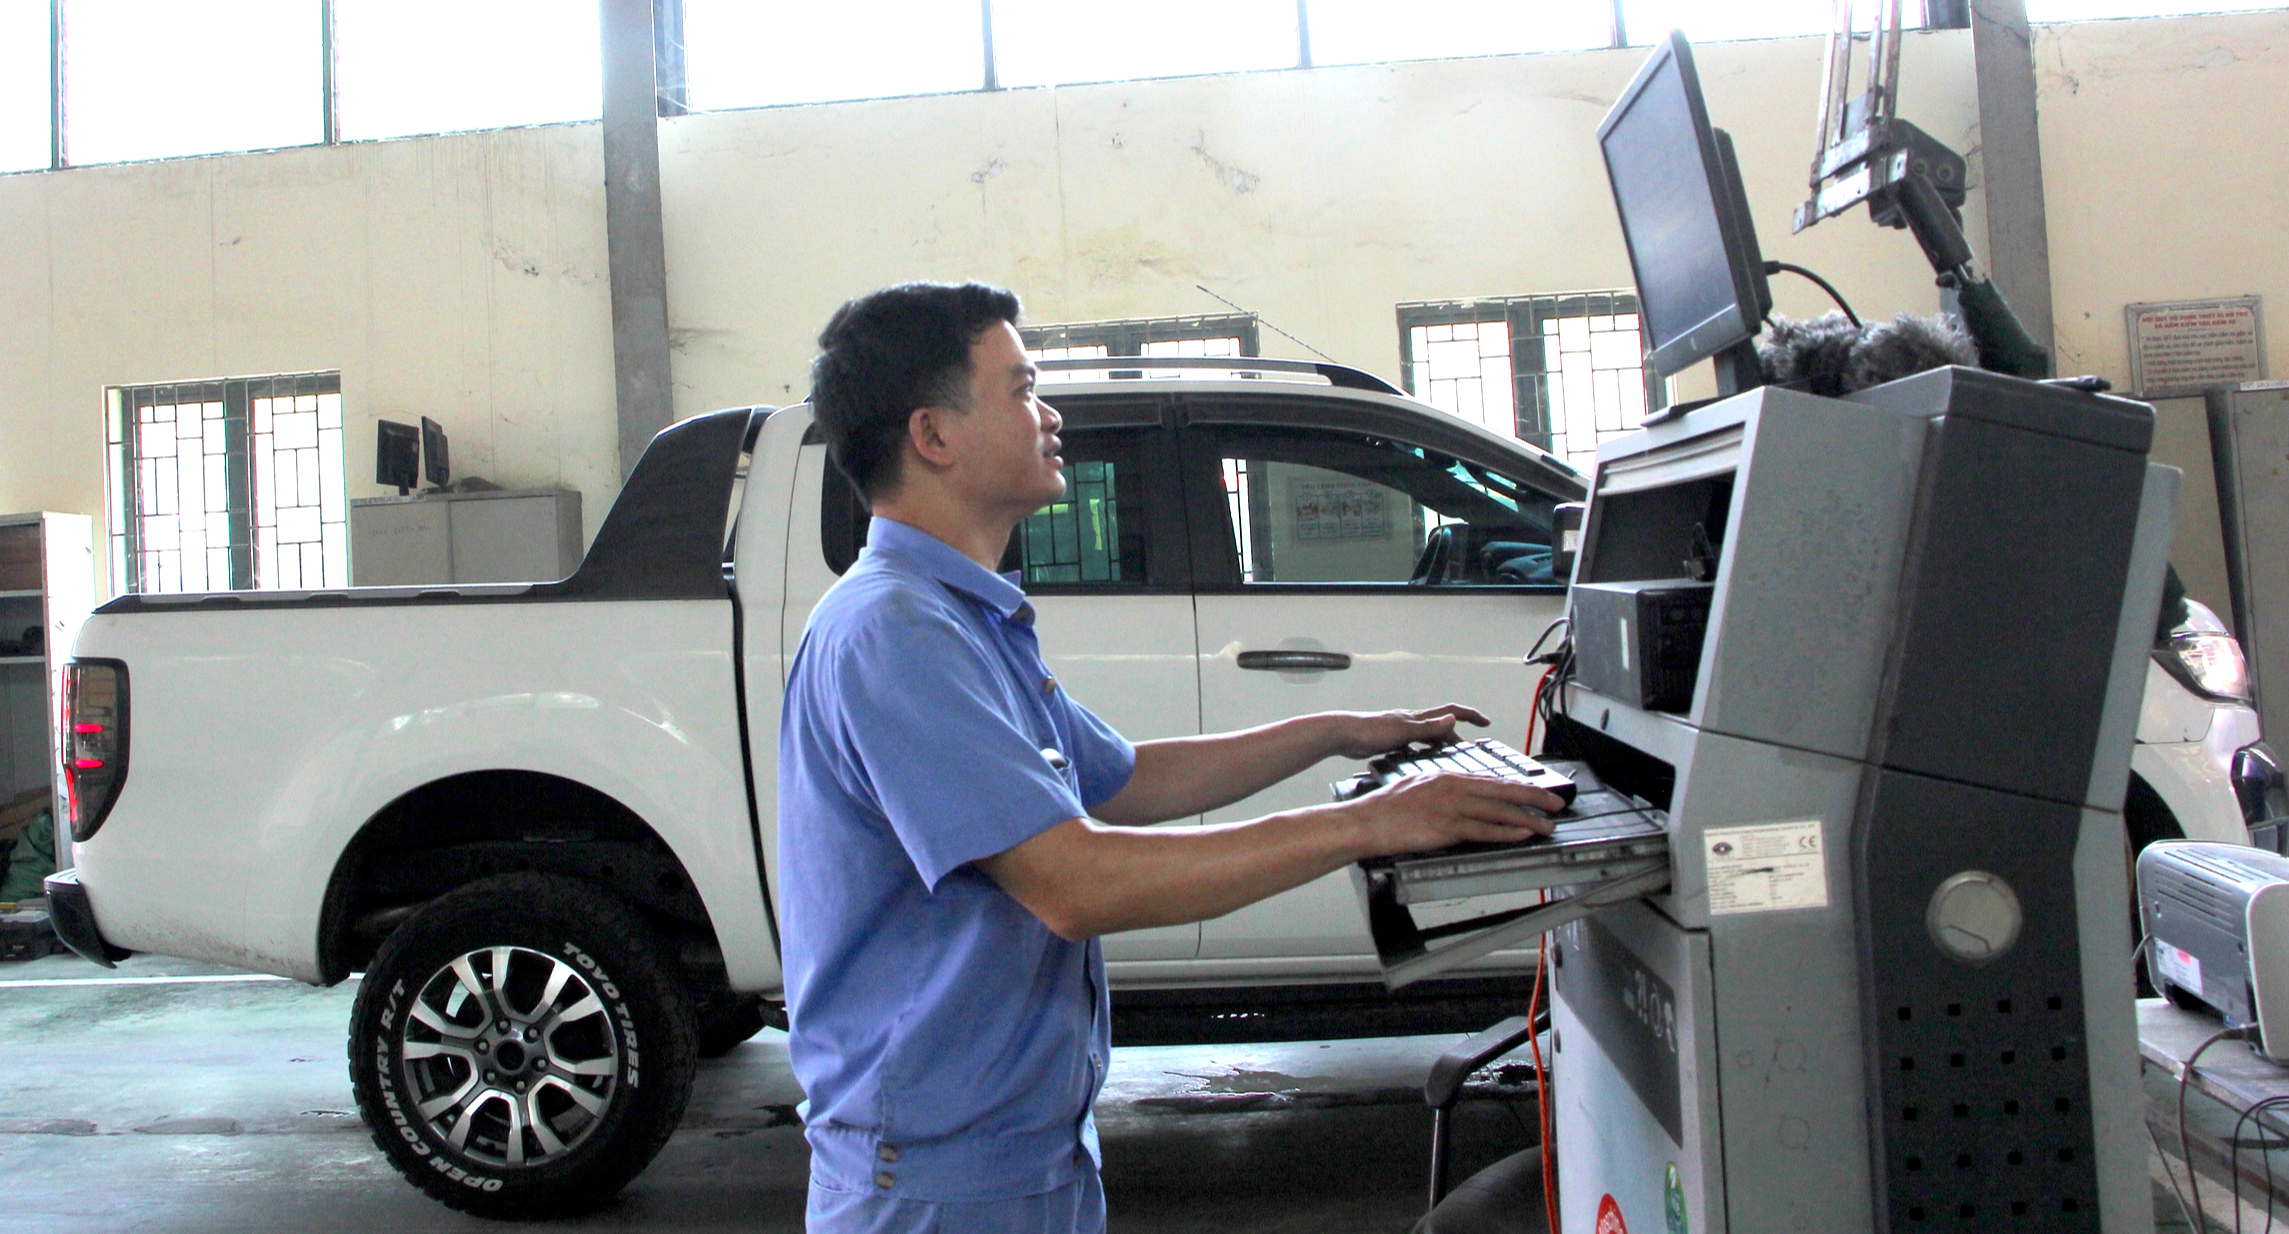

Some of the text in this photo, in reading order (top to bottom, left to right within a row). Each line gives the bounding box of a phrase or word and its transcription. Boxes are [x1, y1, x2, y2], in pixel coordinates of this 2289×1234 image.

[377, 978, 503, 1192] OPEN COUNTRY R/T
[563, 941, 639, 1088] TOYO TIRES
